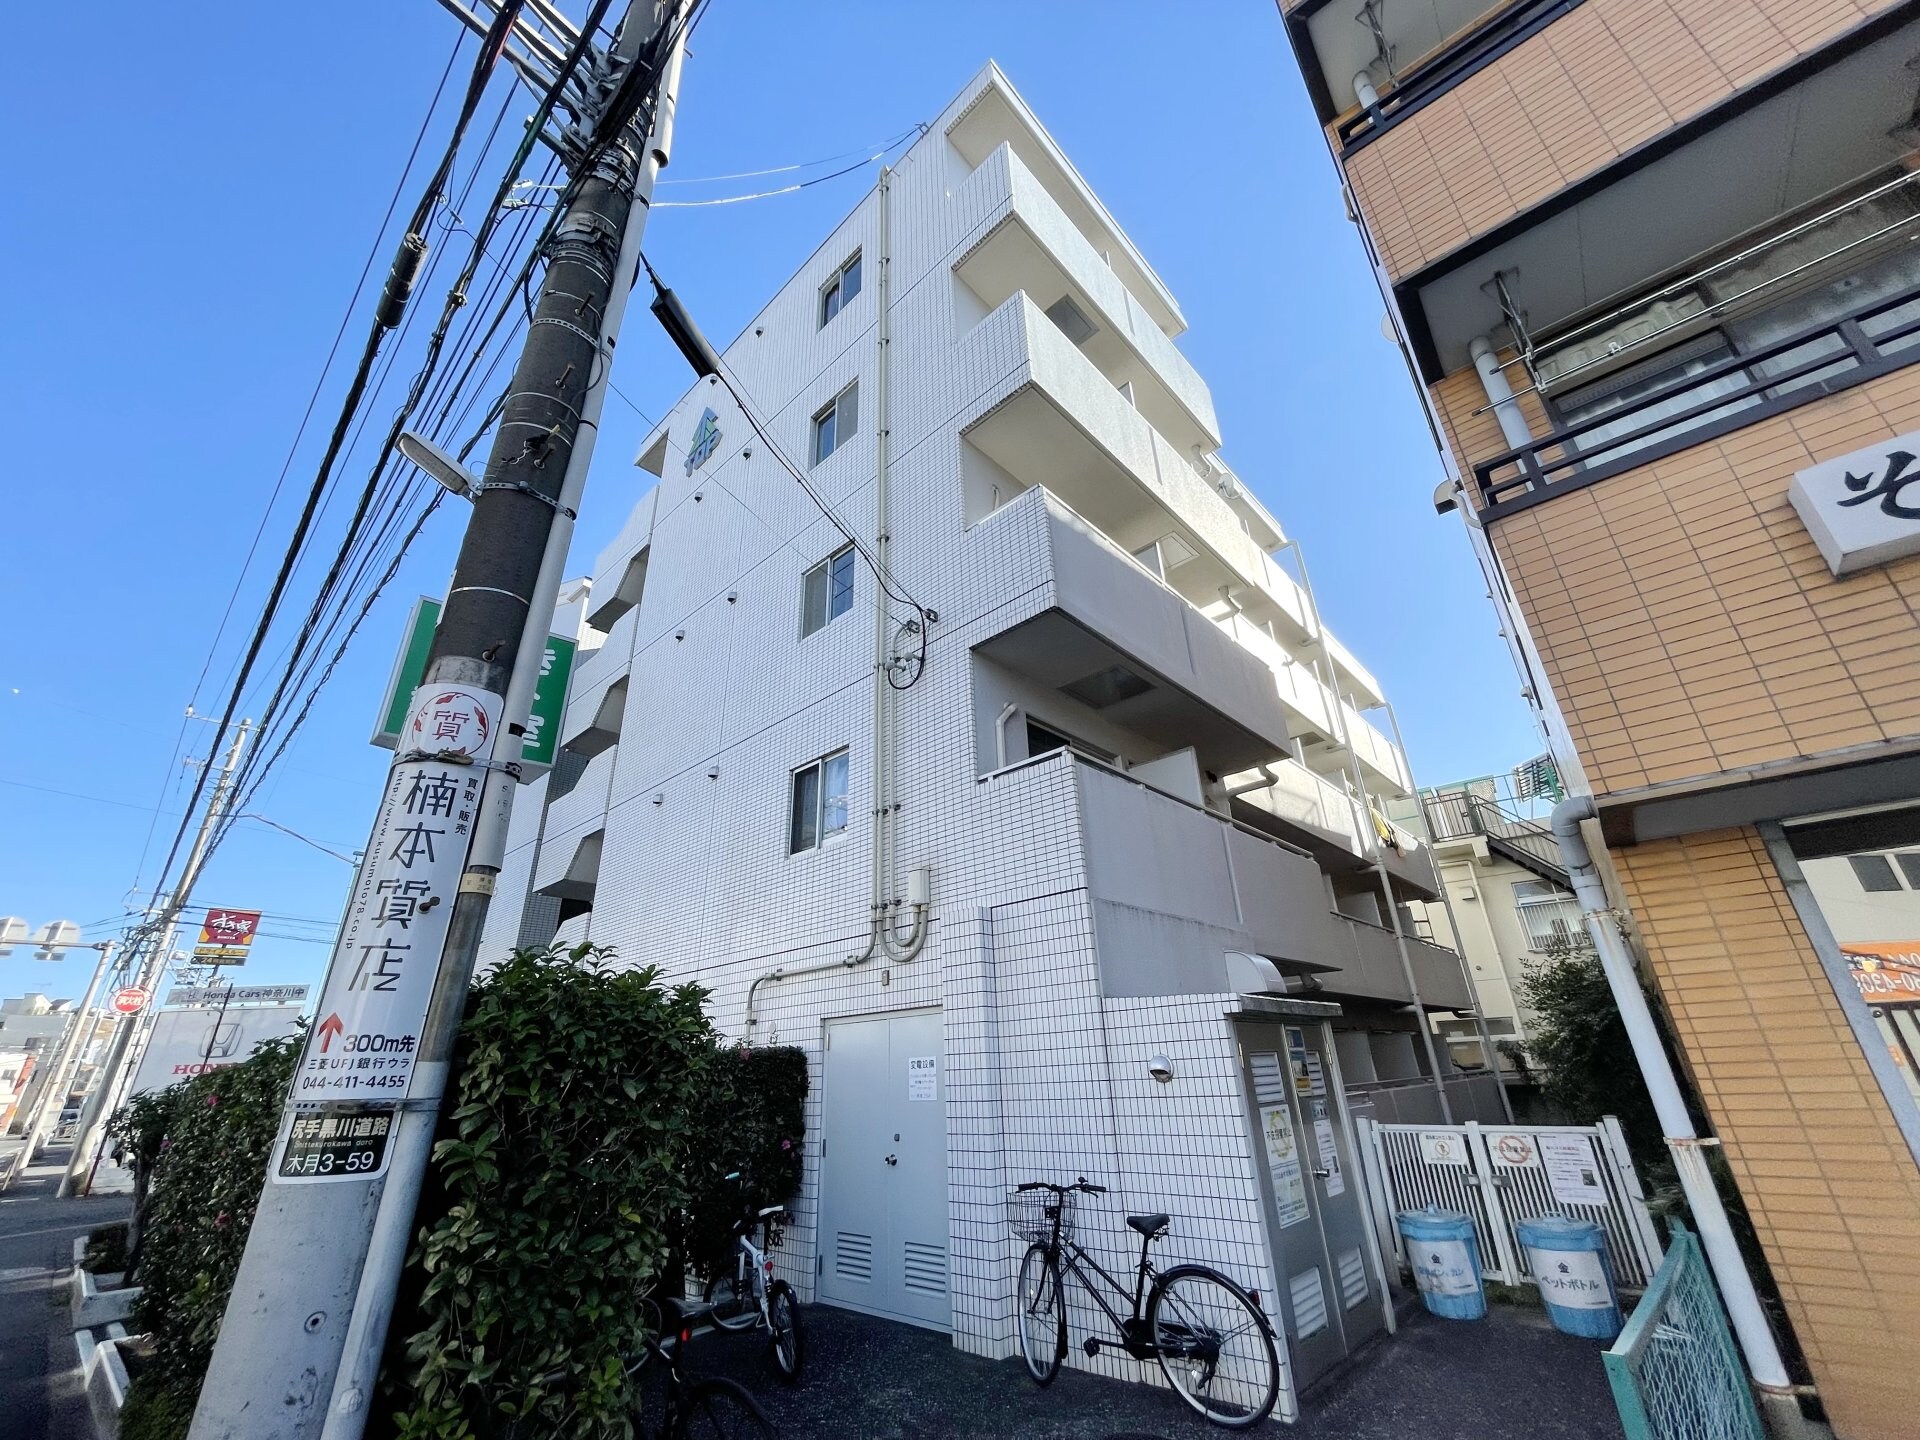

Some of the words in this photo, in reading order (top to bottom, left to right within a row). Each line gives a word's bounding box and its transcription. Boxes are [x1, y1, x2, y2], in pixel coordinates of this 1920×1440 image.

[432, 710, 470, 742] 質
[454, 777, 479, 835] 買取・販売
[345, 771, 406, 949] http://www.kusumoto78.co.jp
[347, 769, 459, 992] 楠本質店
[211, 912, 253, 935] すき家
[238, 989, 261, 998] Cars
[343, 1034, 416, 1053] 300m先
[307, 1057, 411, 1071] 三菱UFJ銀行ウラ
[302, 1075, 406, 1090] 044-411-4455
[291, 1117, 390, 1139] 尻手黒川道路
[286, 1151, 375, 1173] 木月3-59
[1541, 1275, 1600, 1291] ペットボトル
